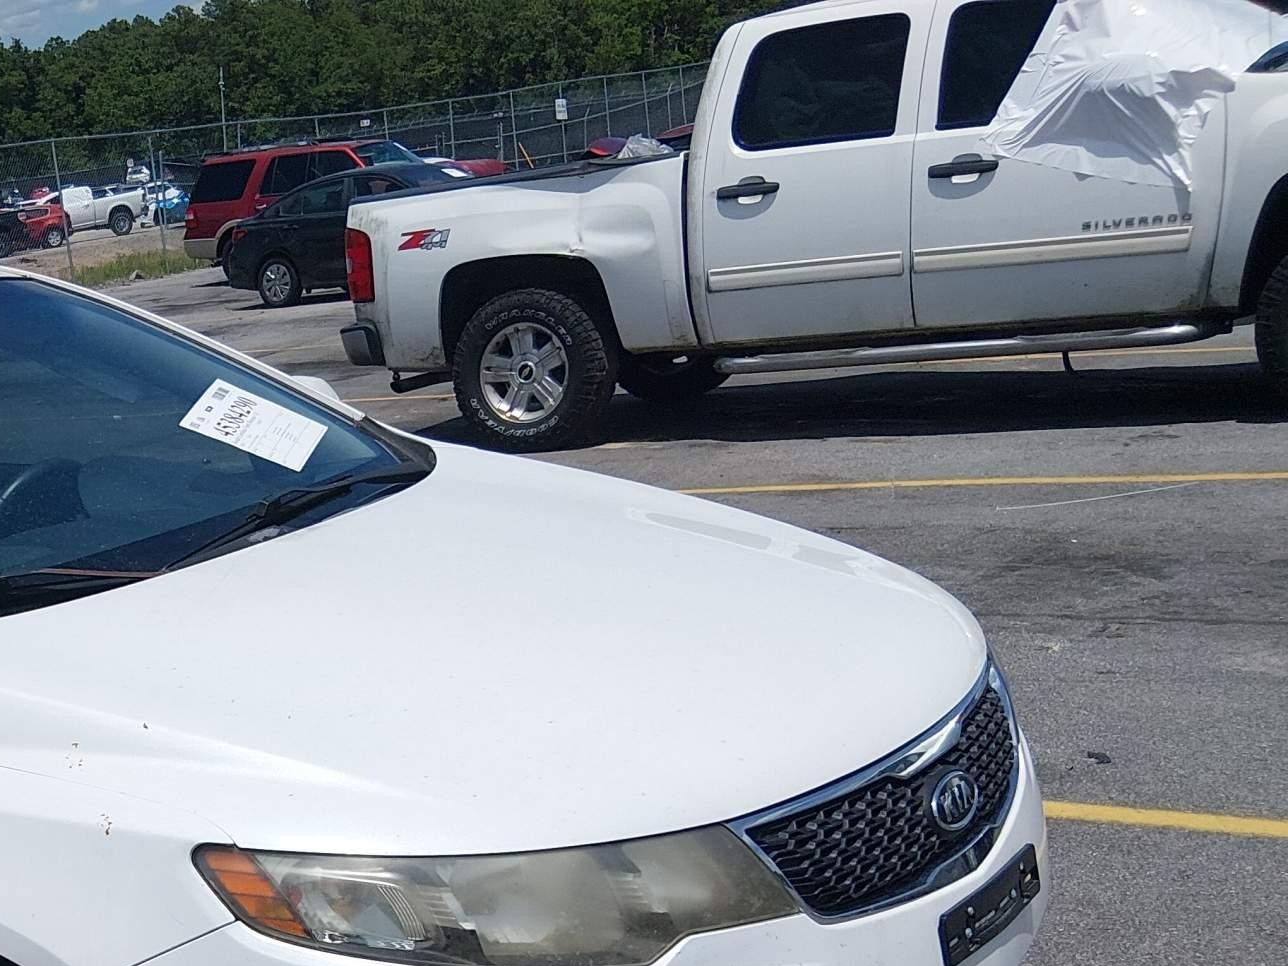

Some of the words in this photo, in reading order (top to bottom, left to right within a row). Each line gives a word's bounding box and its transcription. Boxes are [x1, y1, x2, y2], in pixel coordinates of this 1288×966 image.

[1082, 213, 1192, 231] SILVERADO
[397, 228, 451, 251] Z71
[213, 396, 257, 437] 45384290
[470, 398, 559, 437] GOODYEAR
